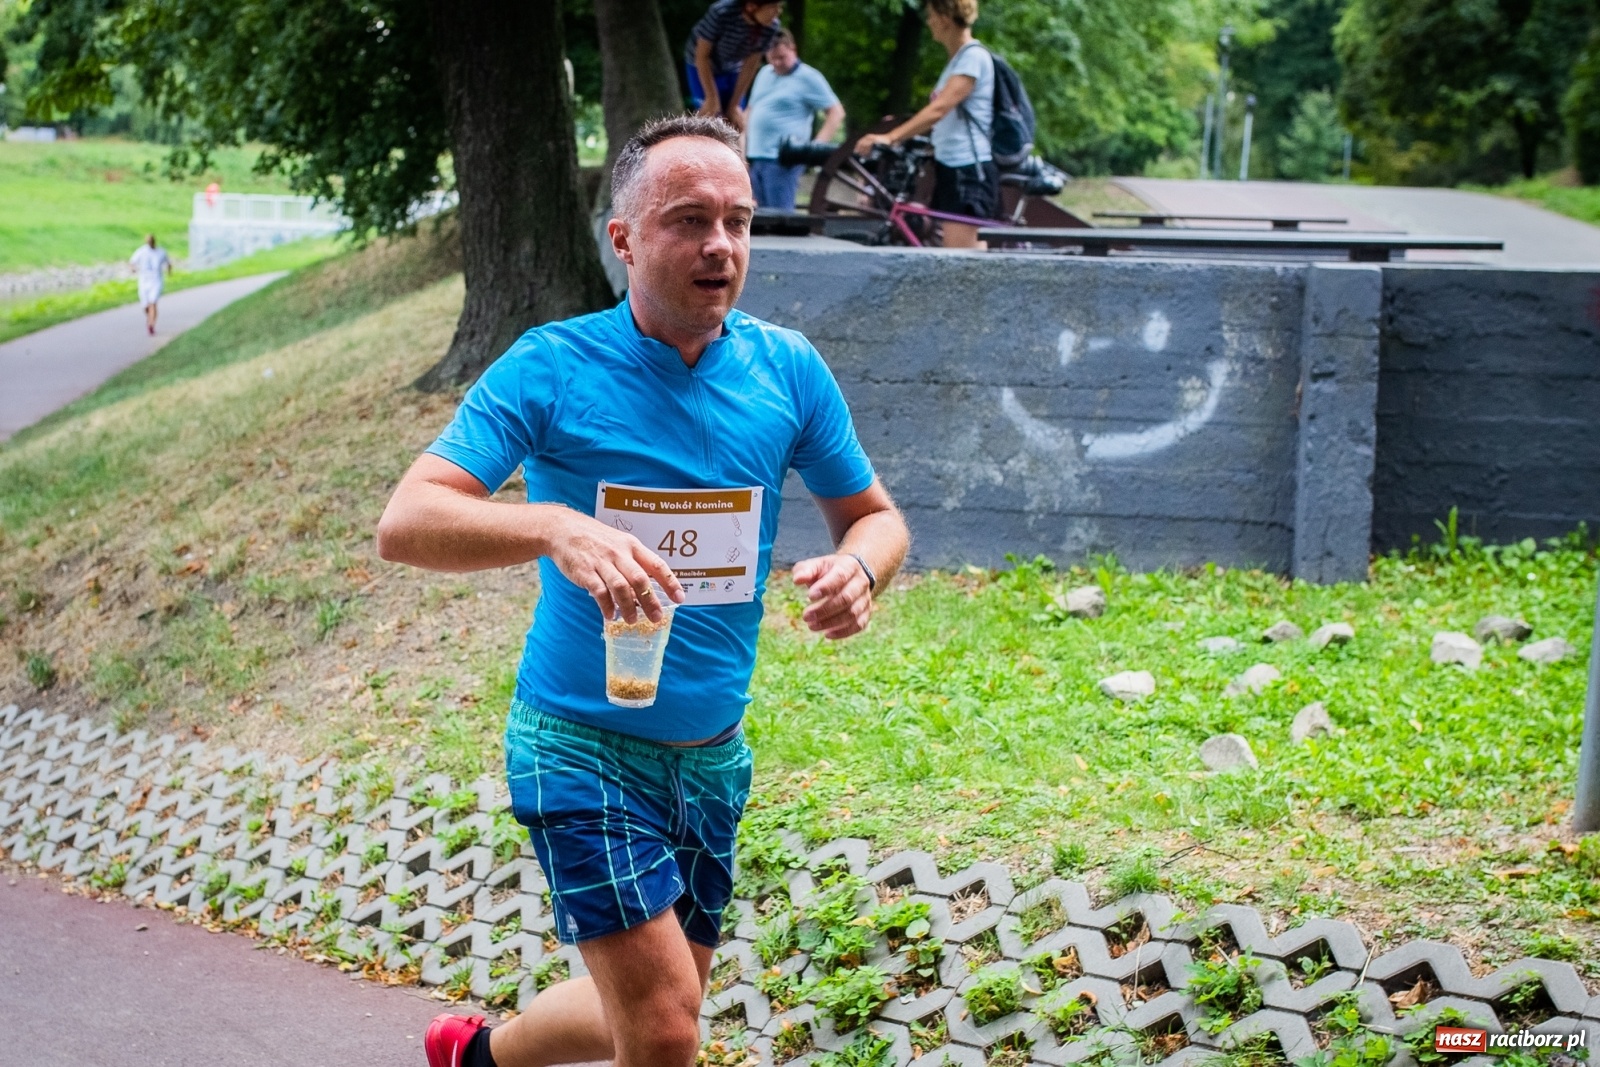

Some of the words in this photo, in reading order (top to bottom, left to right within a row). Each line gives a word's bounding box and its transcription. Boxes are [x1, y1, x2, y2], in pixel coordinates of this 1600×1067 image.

[632, 498, 656, 510] Bieg
[660, 500, 692, 510] Wokół
[696, 499, 734, 509] Komina
[657, 529, 698, 557] 48
